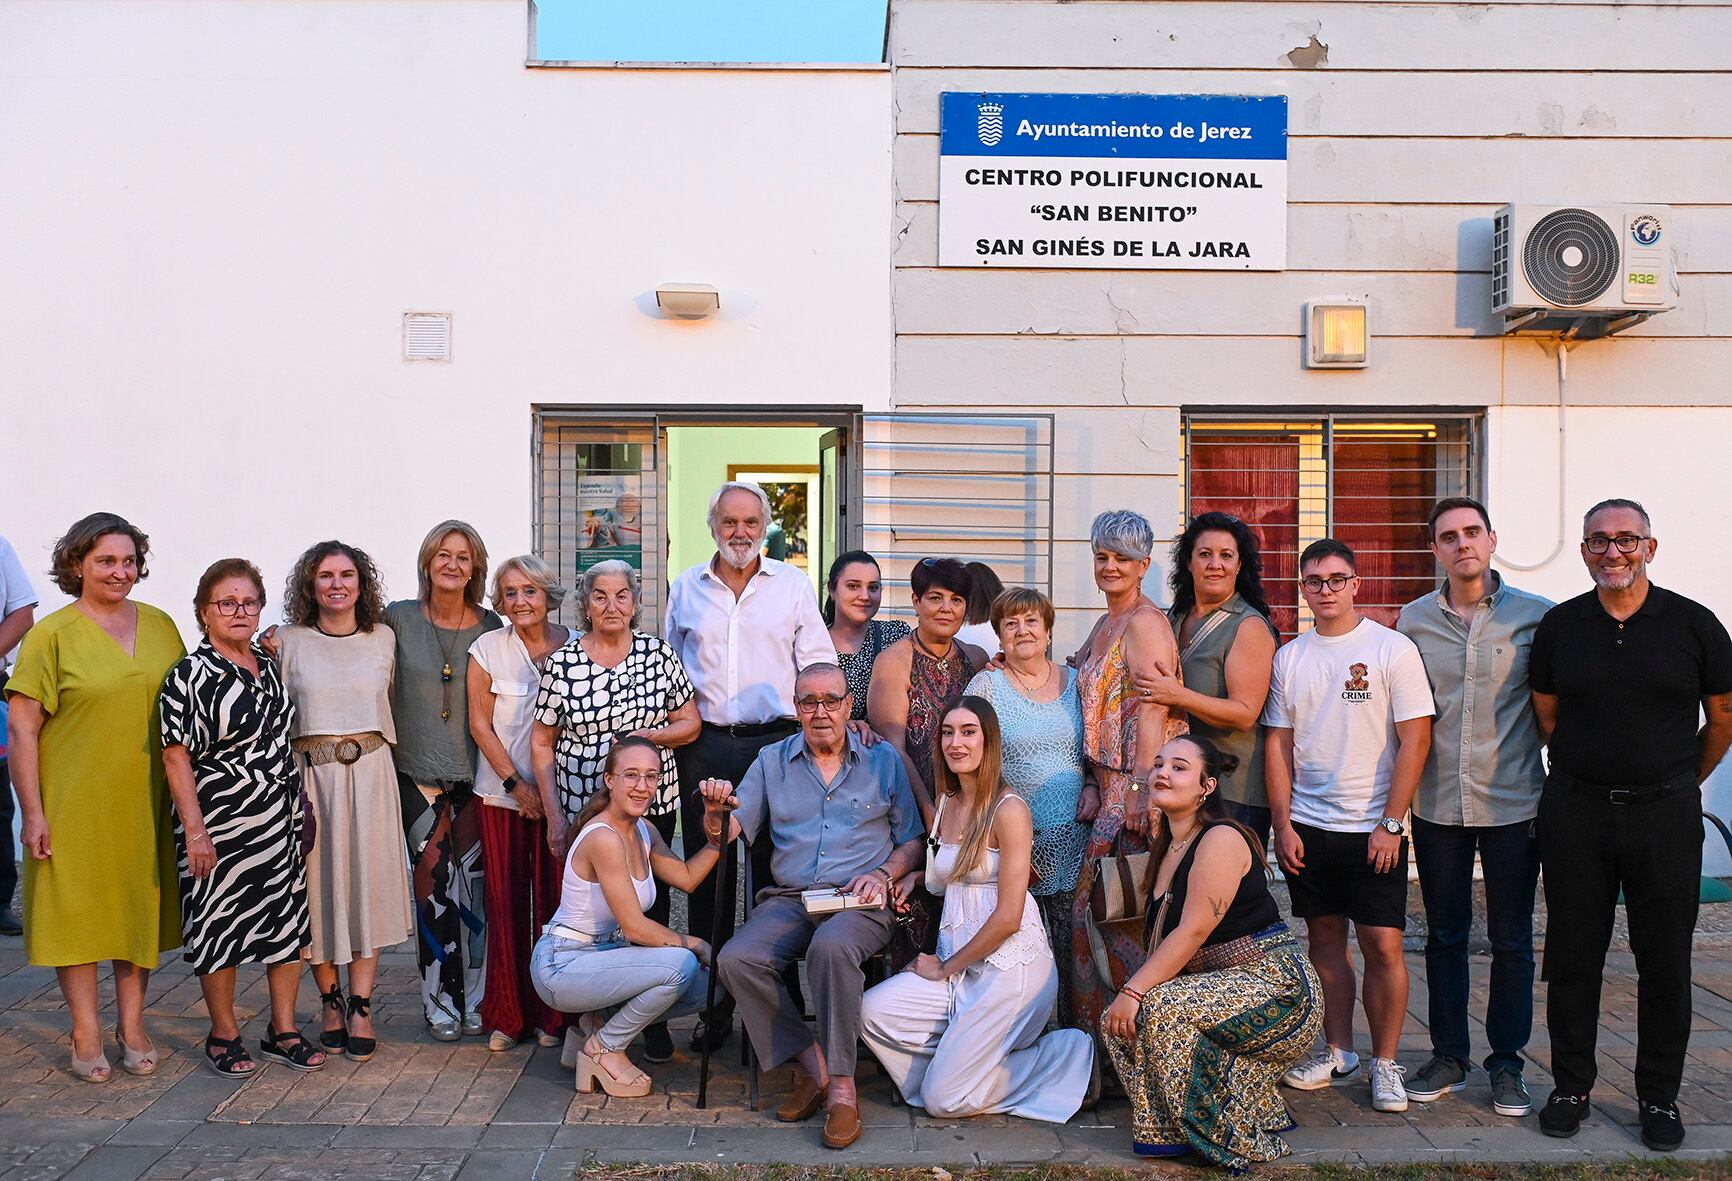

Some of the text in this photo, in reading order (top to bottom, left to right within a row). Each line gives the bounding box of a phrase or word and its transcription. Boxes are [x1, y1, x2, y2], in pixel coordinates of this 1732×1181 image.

[1016, 119, 1252, 143] Ayuntamiento de Jerez
[965, 168, 1263, 189] CENTRO POLIFUNCIONAL
[1030, 204, 1197, 223] “SAN BENITO”
[975, 236, 1251, 258] SAN GINÉS DE LA JARA
[1628, 273, 1655, 285] R32
[1341, 691, 1372, 700] CRIME
